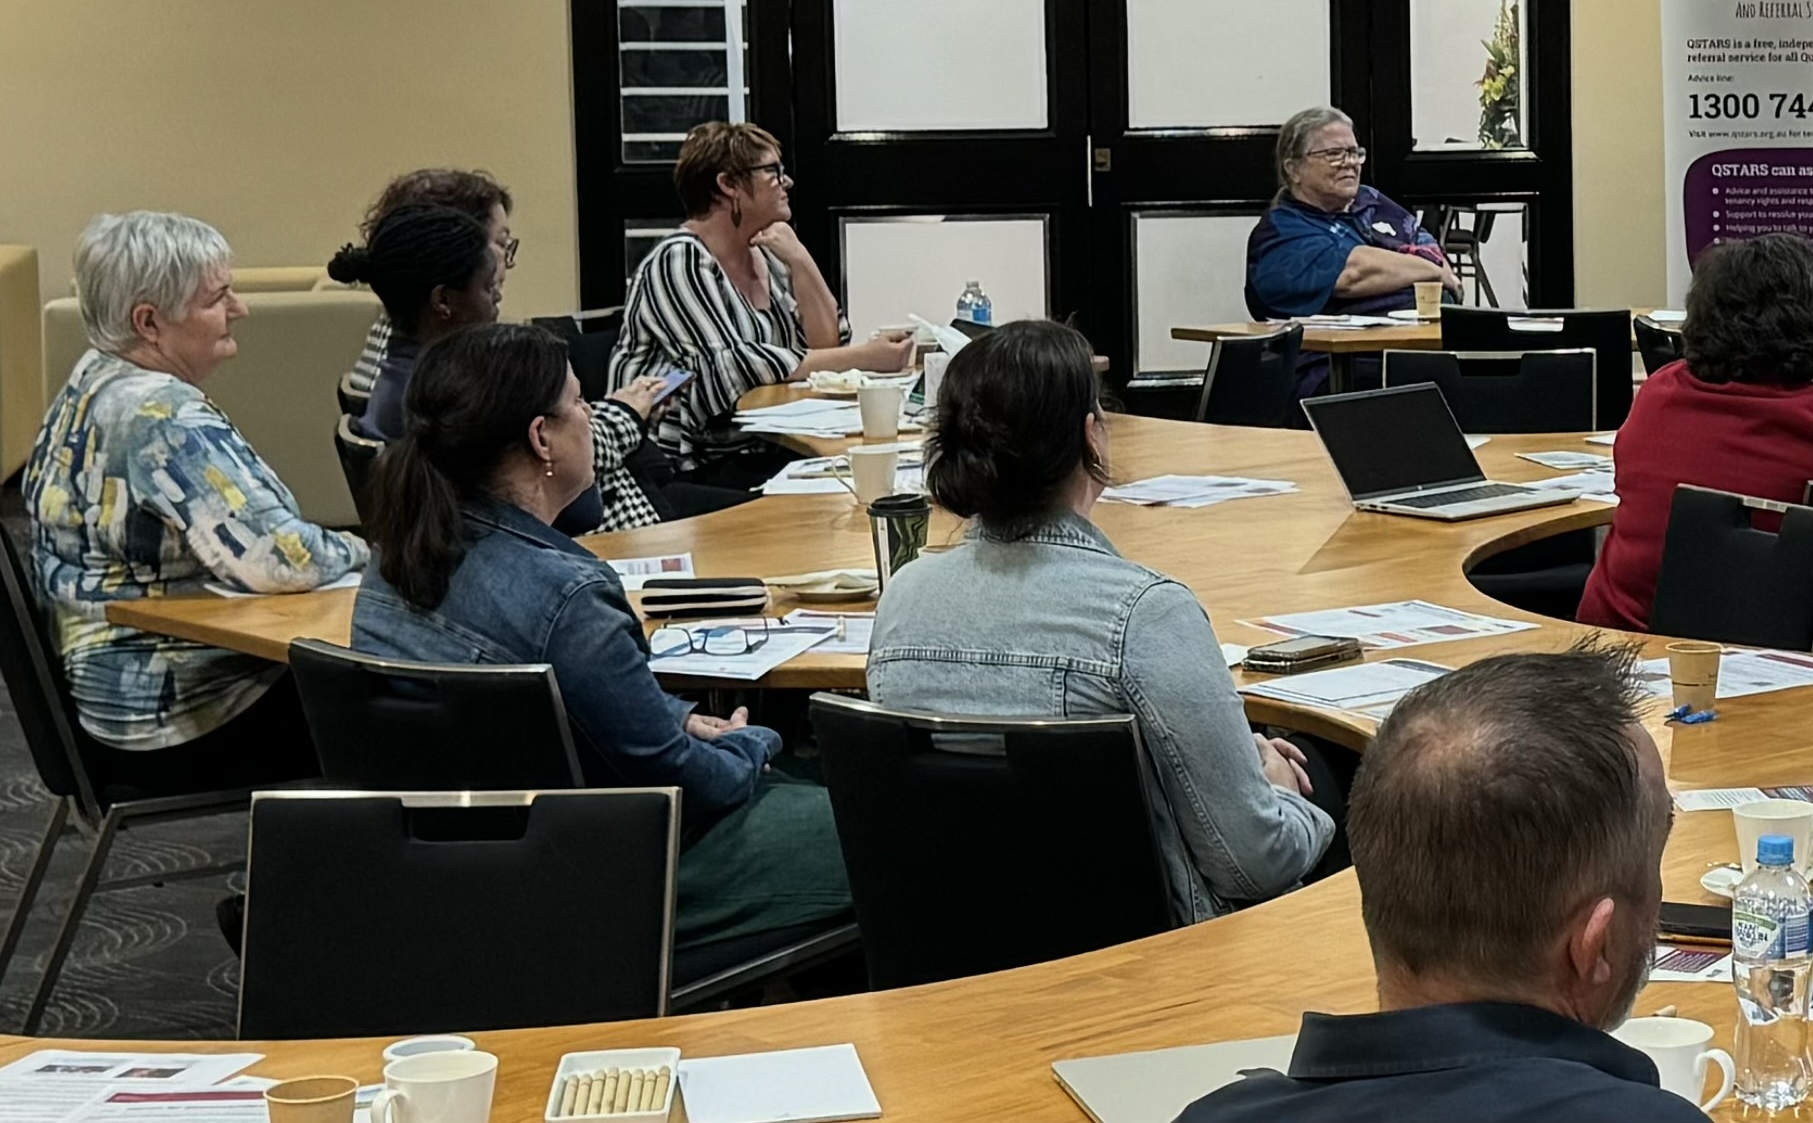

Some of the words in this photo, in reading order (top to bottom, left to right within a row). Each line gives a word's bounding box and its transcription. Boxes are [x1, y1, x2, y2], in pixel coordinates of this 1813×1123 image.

[1687, 39, 1731, 50] QSTARS
[1733, 39, 1743, 49] is
[1744, 41, 1751, 49] a
[1753, 38, 1776, 50] free,
[1687, 52, 1726, 63] referral
[1728, 53, 1766, 63] service
[1768, 52, 1783, 63] for
[1785, 52, 1798, 63] all
[1688, 74, 1714, 83] Advice
[1689, 93, 1760, 120] 1300
[1689, 129, 1706, 138] Visit
[1712, 164, 1769, 177] QSTARS
[1771, 166, 1796, 177] can
[1752, 186, 1768, 195] and
[1781, 197, 1796, 205] and
[1726, 210, 1757, 219] Support
